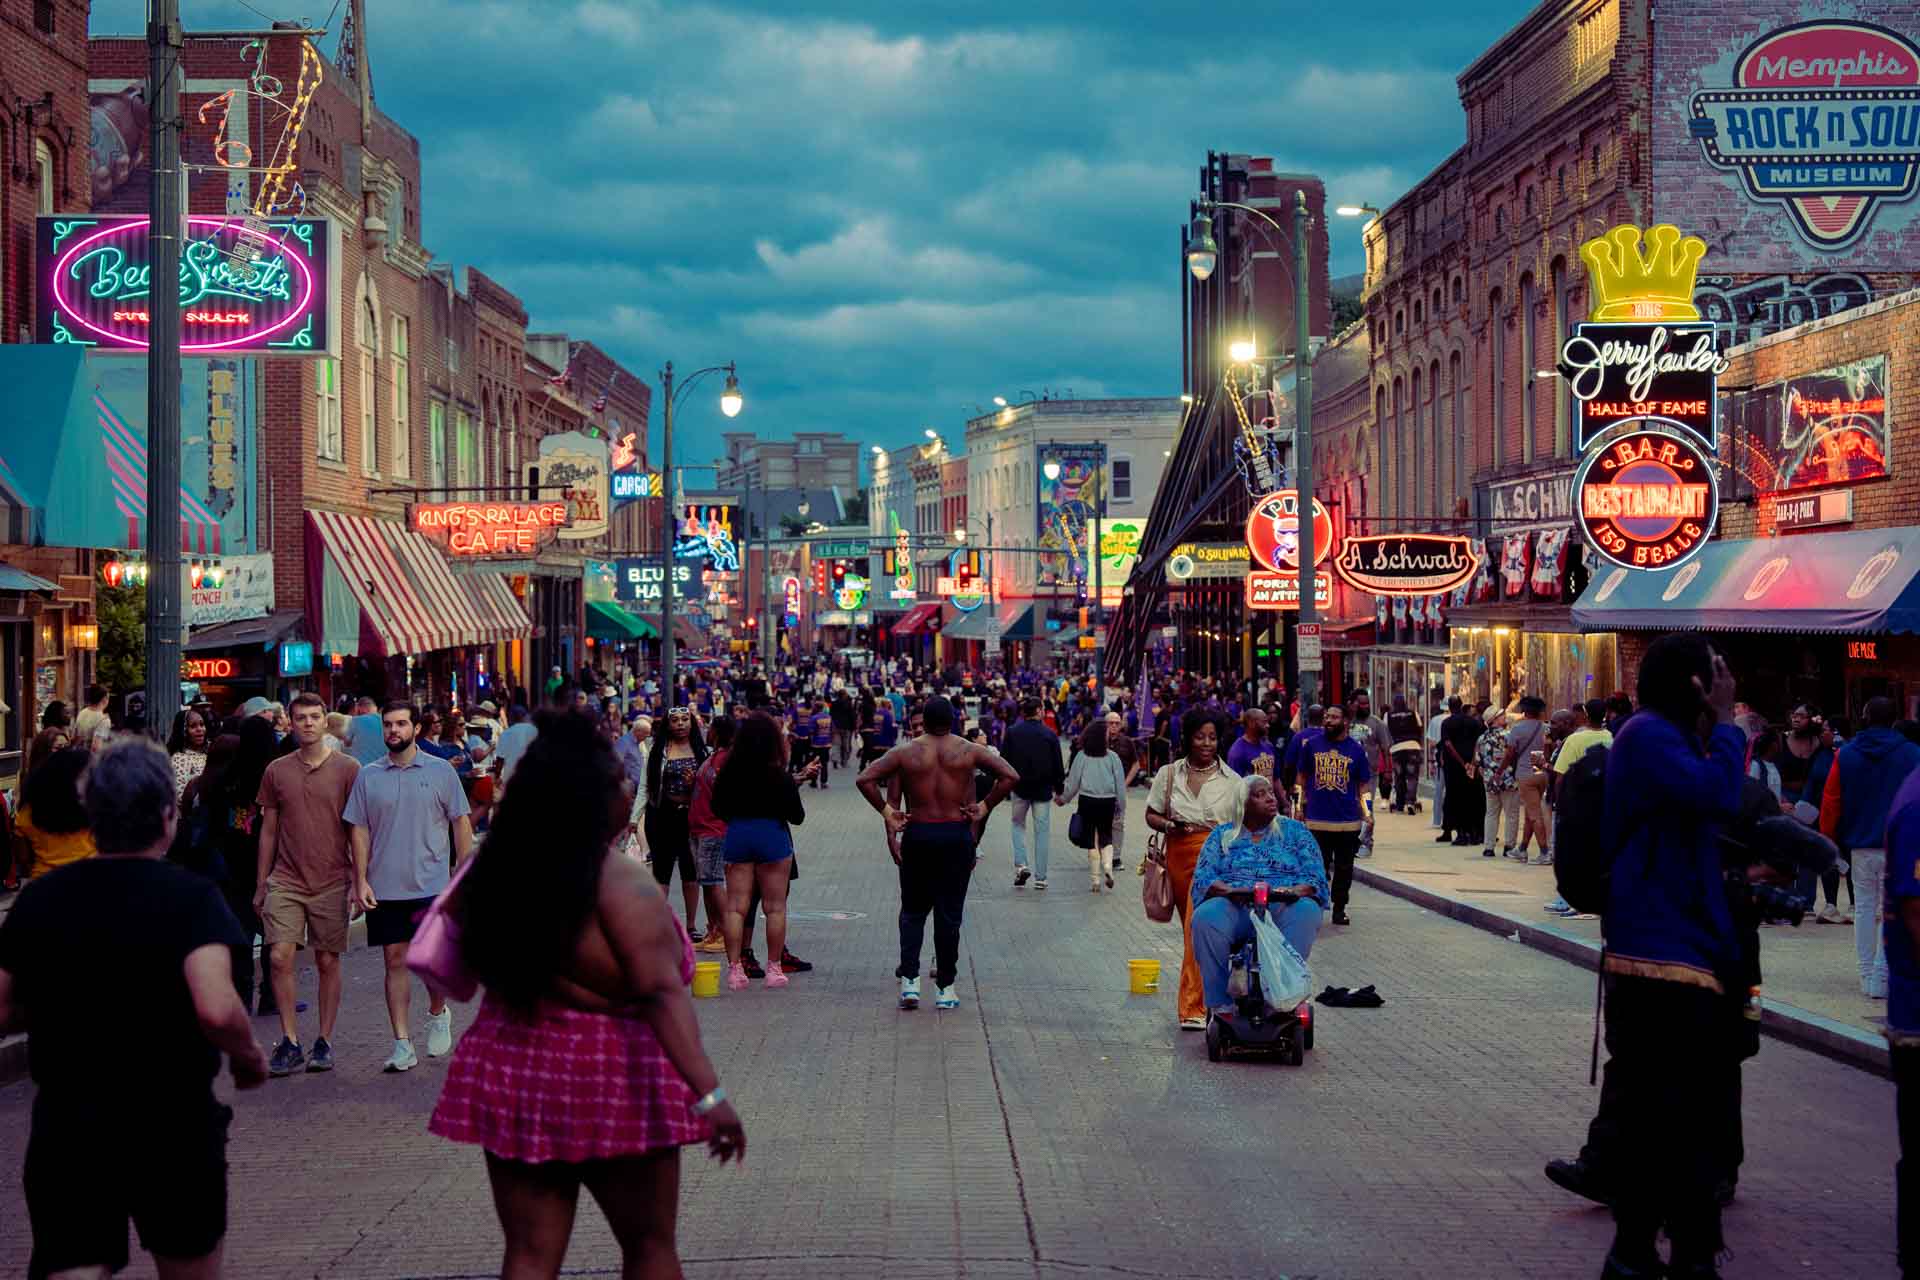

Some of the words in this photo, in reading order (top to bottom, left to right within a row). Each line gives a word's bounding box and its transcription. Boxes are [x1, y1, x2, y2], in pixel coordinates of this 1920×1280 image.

[1756, 49, 1909, 89] Memphis
[1726, 106, 1820, 149] ROCK
[1850, 105, 1920, 148] SOU
[185, 311, 249, 323] SHACK
[1563, 336, 1652, 400] Jerry
[1630, 327, 1730, 403] Lawler
[1589, 402, 1632, 417] HALL
[1635, 402, 1658, 415] OF
[1662, 401, 1707, 415] FAME
[1615, 437, 1680, 466] BAR
[1584, 483, 1708, 518] RESTAURANT
[450, 530, 532, 551] CAFE
[1594, 523, 1627, 553] 159
[1633, 522, 1702, 564] BEALE
[1372, 540, 1470, 571] Schwab
[627, 566, 691, 583] BLUES
[1253, 578, 1290, 589] PORK
[634, 583, 684, 599] HAL
[1301, 625, 1316, 634] NO
[1847, 641, 1860, 659] LIVE
[1860, 641, 1877, 660] MUSIC
